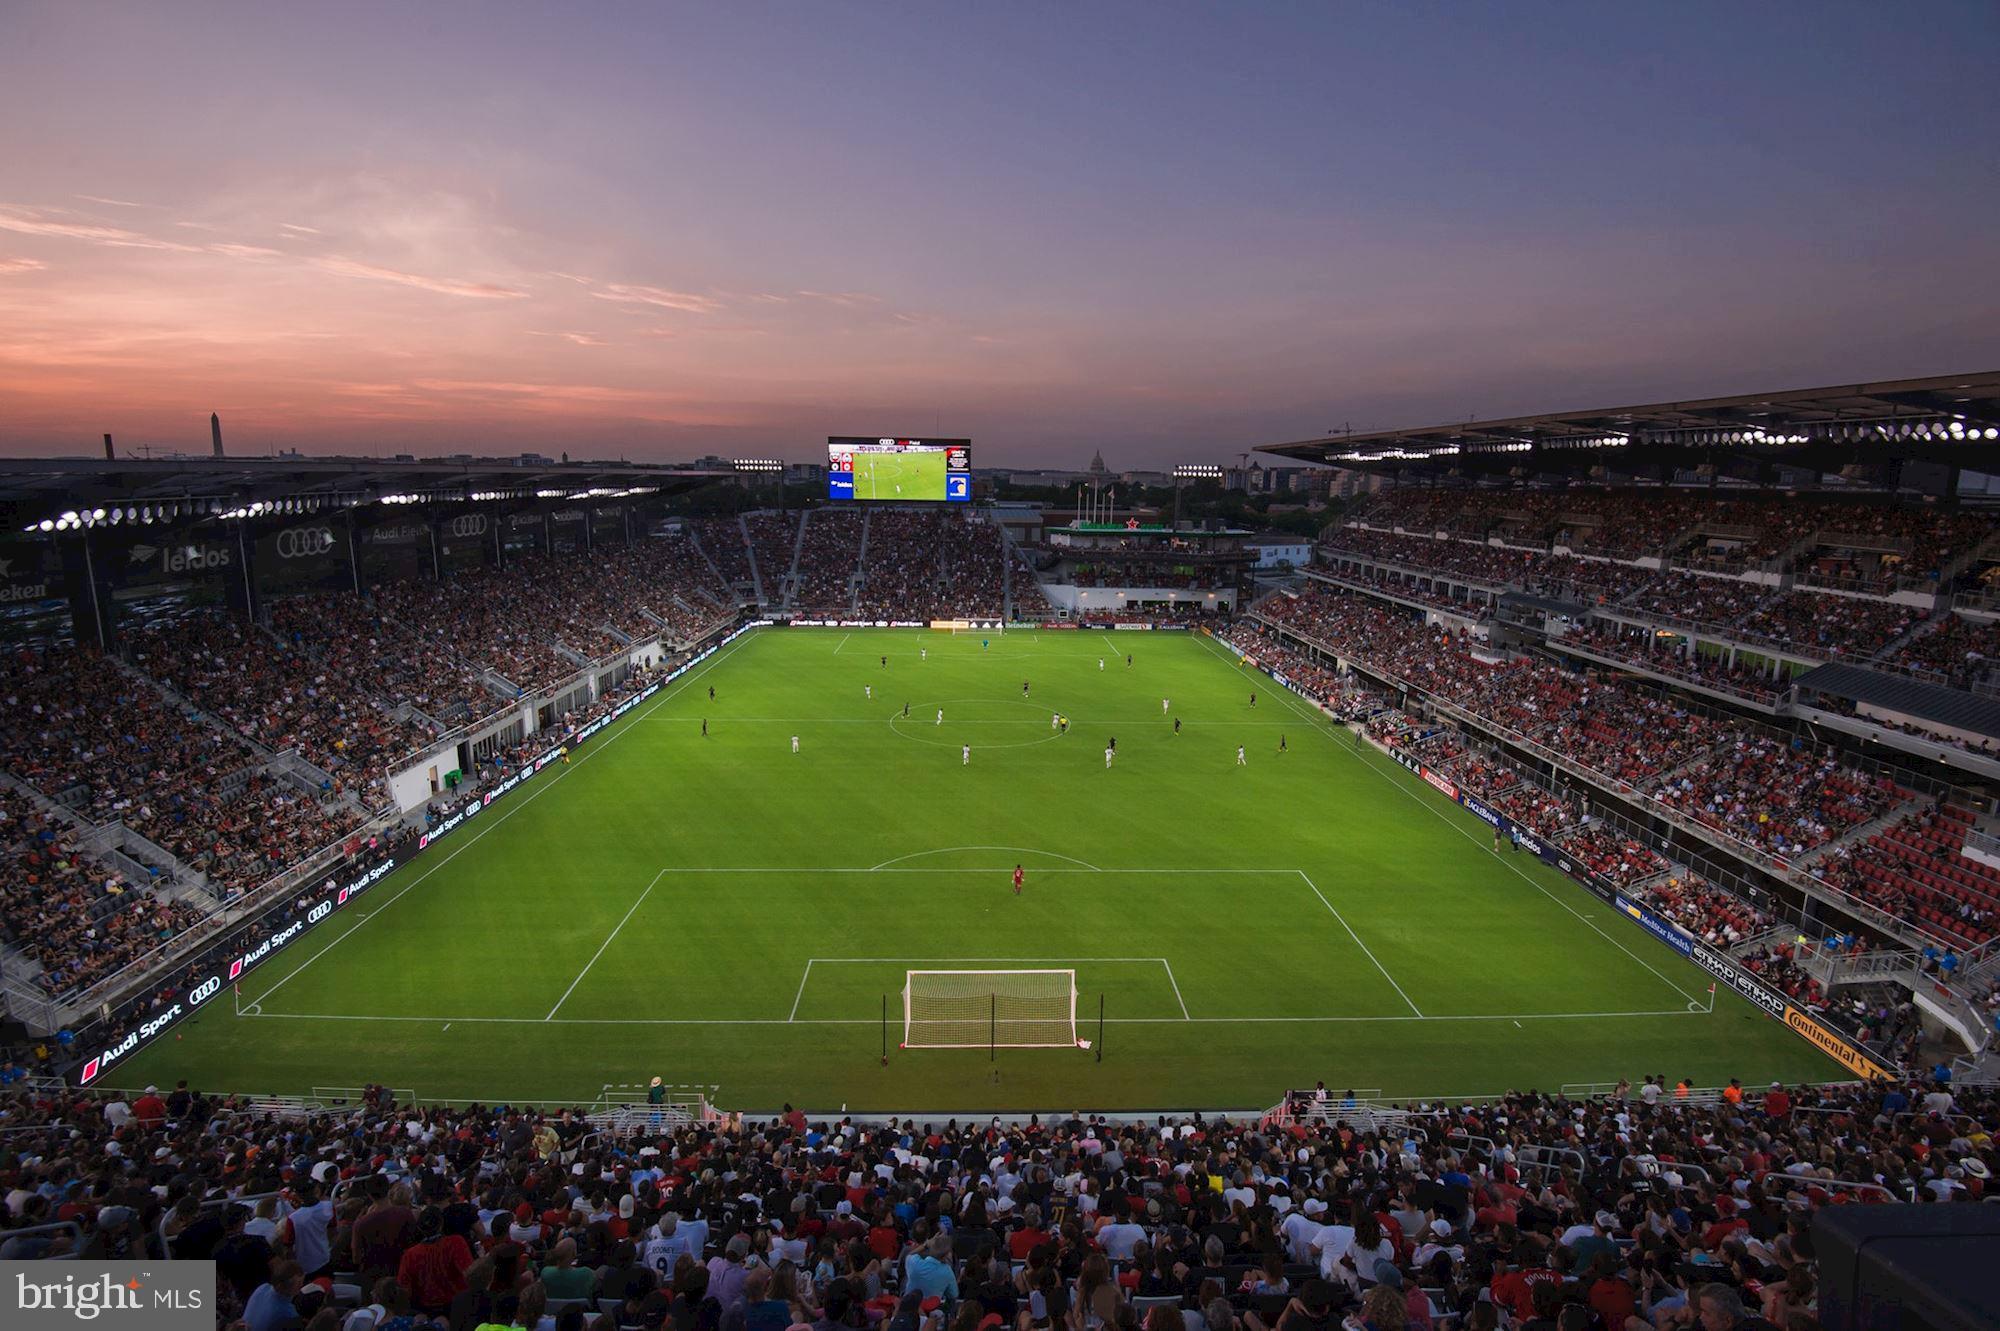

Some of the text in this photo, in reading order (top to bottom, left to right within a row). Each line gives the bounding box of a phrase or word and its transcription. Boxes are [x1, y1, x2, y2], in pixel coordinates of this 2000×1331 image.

[491, 775, 520, 799] Audi Sport
[428, 812, 464, 841] Audi Sport
[1519, 833, 1541, 855] leidos
[349, 859, 394, 896] Audi Sport
[243, 920, 303, 967] Audi Sport
[1641, 914, 1690, 953] MedStar Health
[1693, 947, 1734, 979] ETIHAD
[1738, 977, 1784, 1011] ETIHAD
[101, 1004, 182, 1067] Audi Sport
[1788, 1010, 1856, 1065] Continental
[656, 1256, 668, 1275] 9
